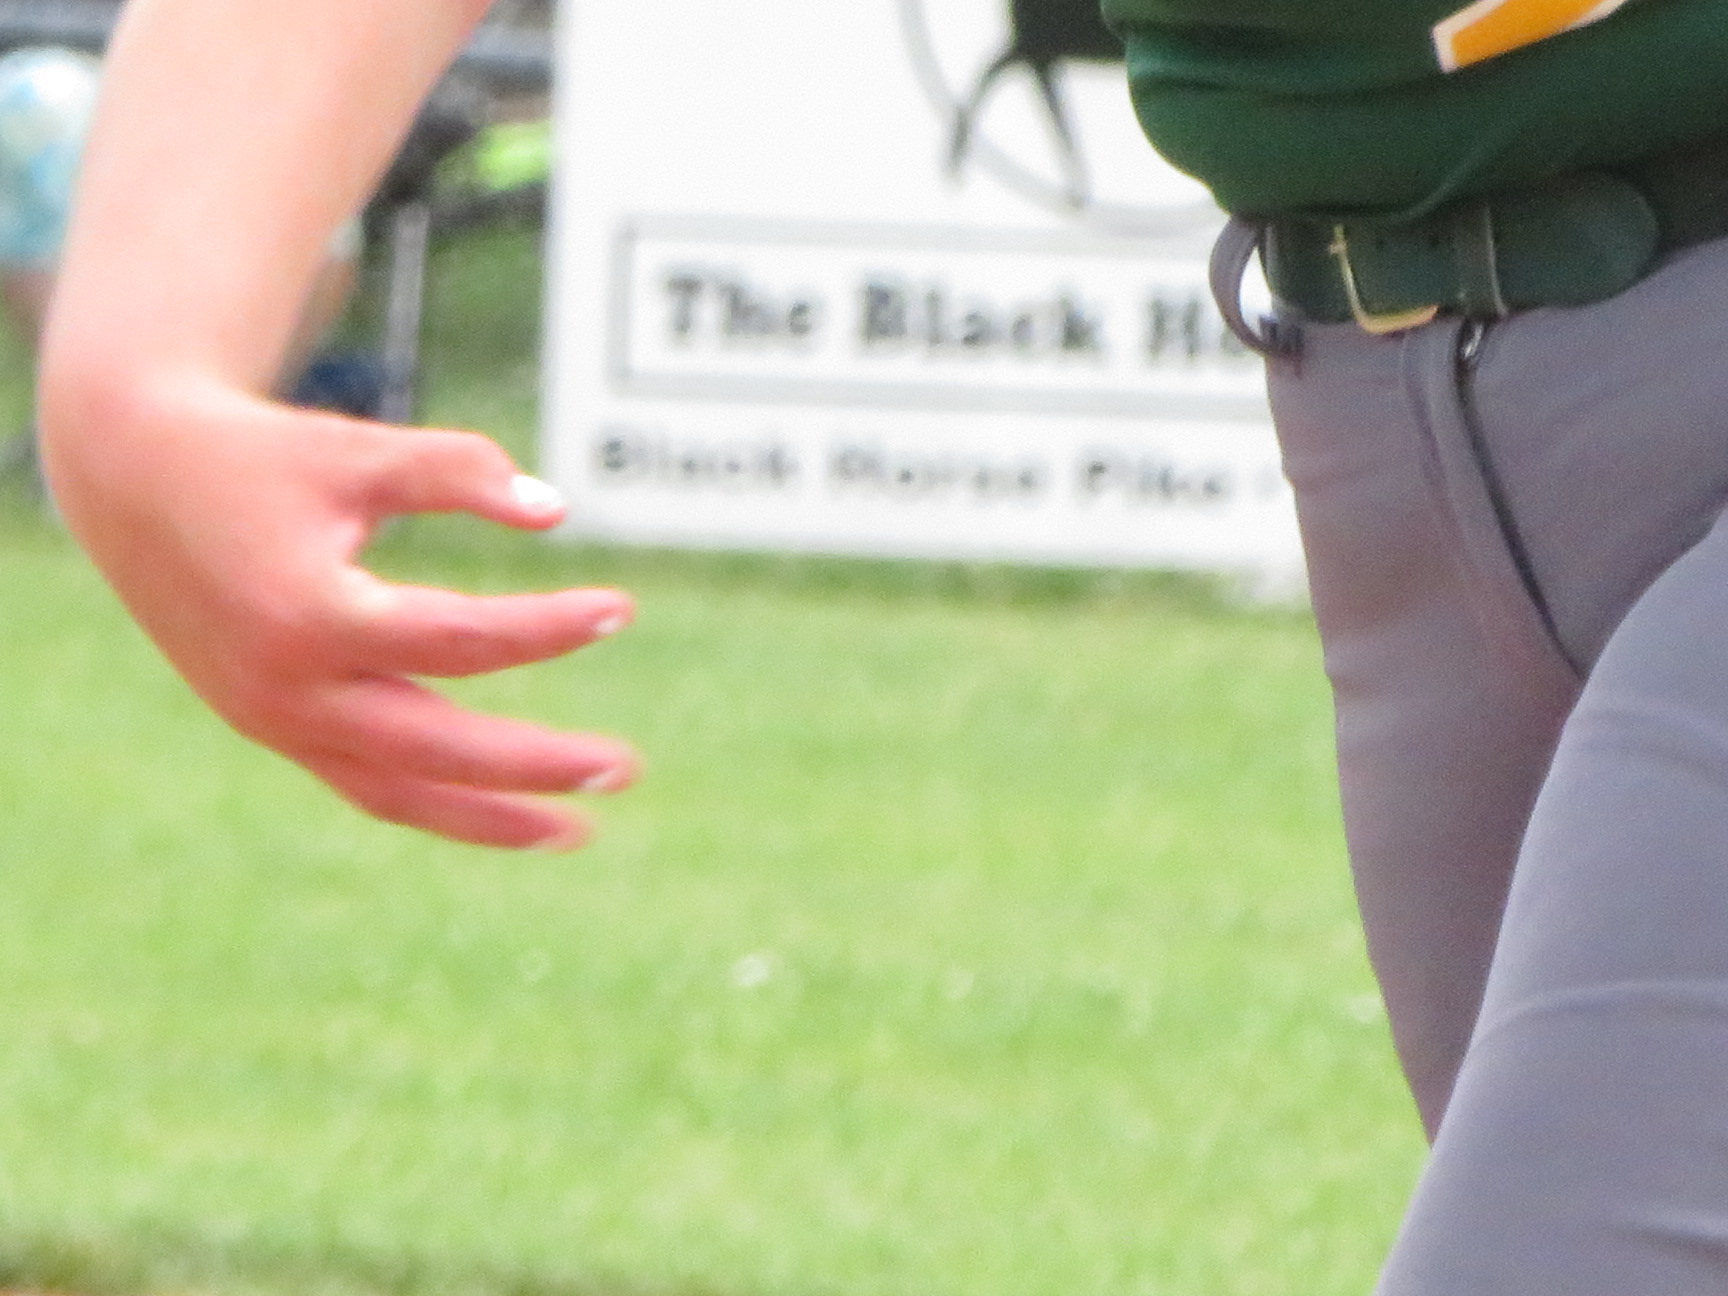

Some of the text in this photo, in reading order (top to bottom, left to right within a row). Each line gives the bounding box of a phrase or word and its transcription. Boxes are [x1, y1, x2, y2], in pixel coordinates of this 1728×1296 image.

[663, 270, 816, 340] The
[860, 275, 1104, 353] Black
[597, 435, 795, 488] Black
[829, 441, 1044, 494] Horse
[1083, 457, 1229, 504] Pike
